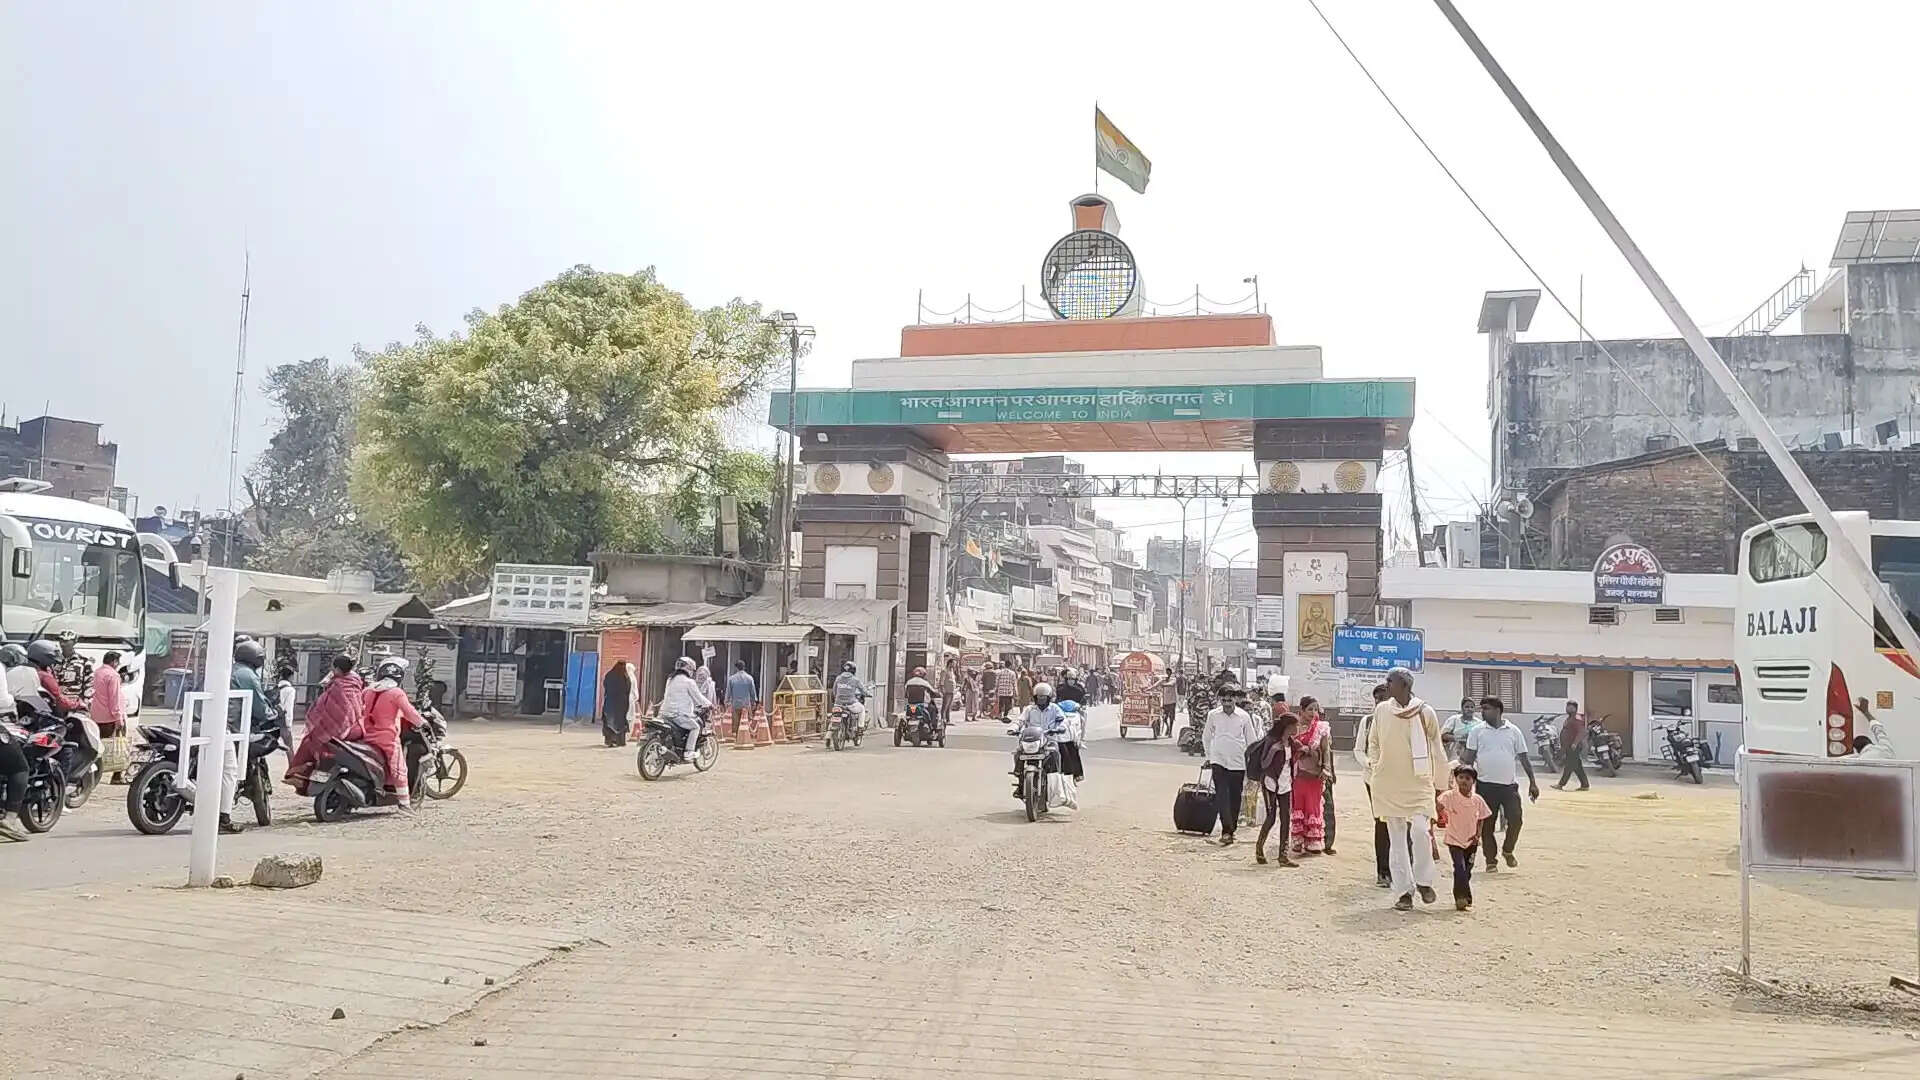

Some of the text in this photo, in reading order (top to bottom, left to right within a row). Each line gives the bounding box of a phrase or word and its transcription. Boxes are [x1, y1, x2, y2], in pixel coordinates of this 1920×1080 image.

[901, 397, 944, 409] भारत
[944, 396, 1008, 408] आगमन
[1010, 396, 1034, 407] पर
[1035, 394, 1096, 407] आपका
[997, 408, 1133, 420] WELCOME TO INDIA
[1747, 606, 1818, 636] BALAJI
[1337, 629, 1420, 641] WELCOME TO INDIA
